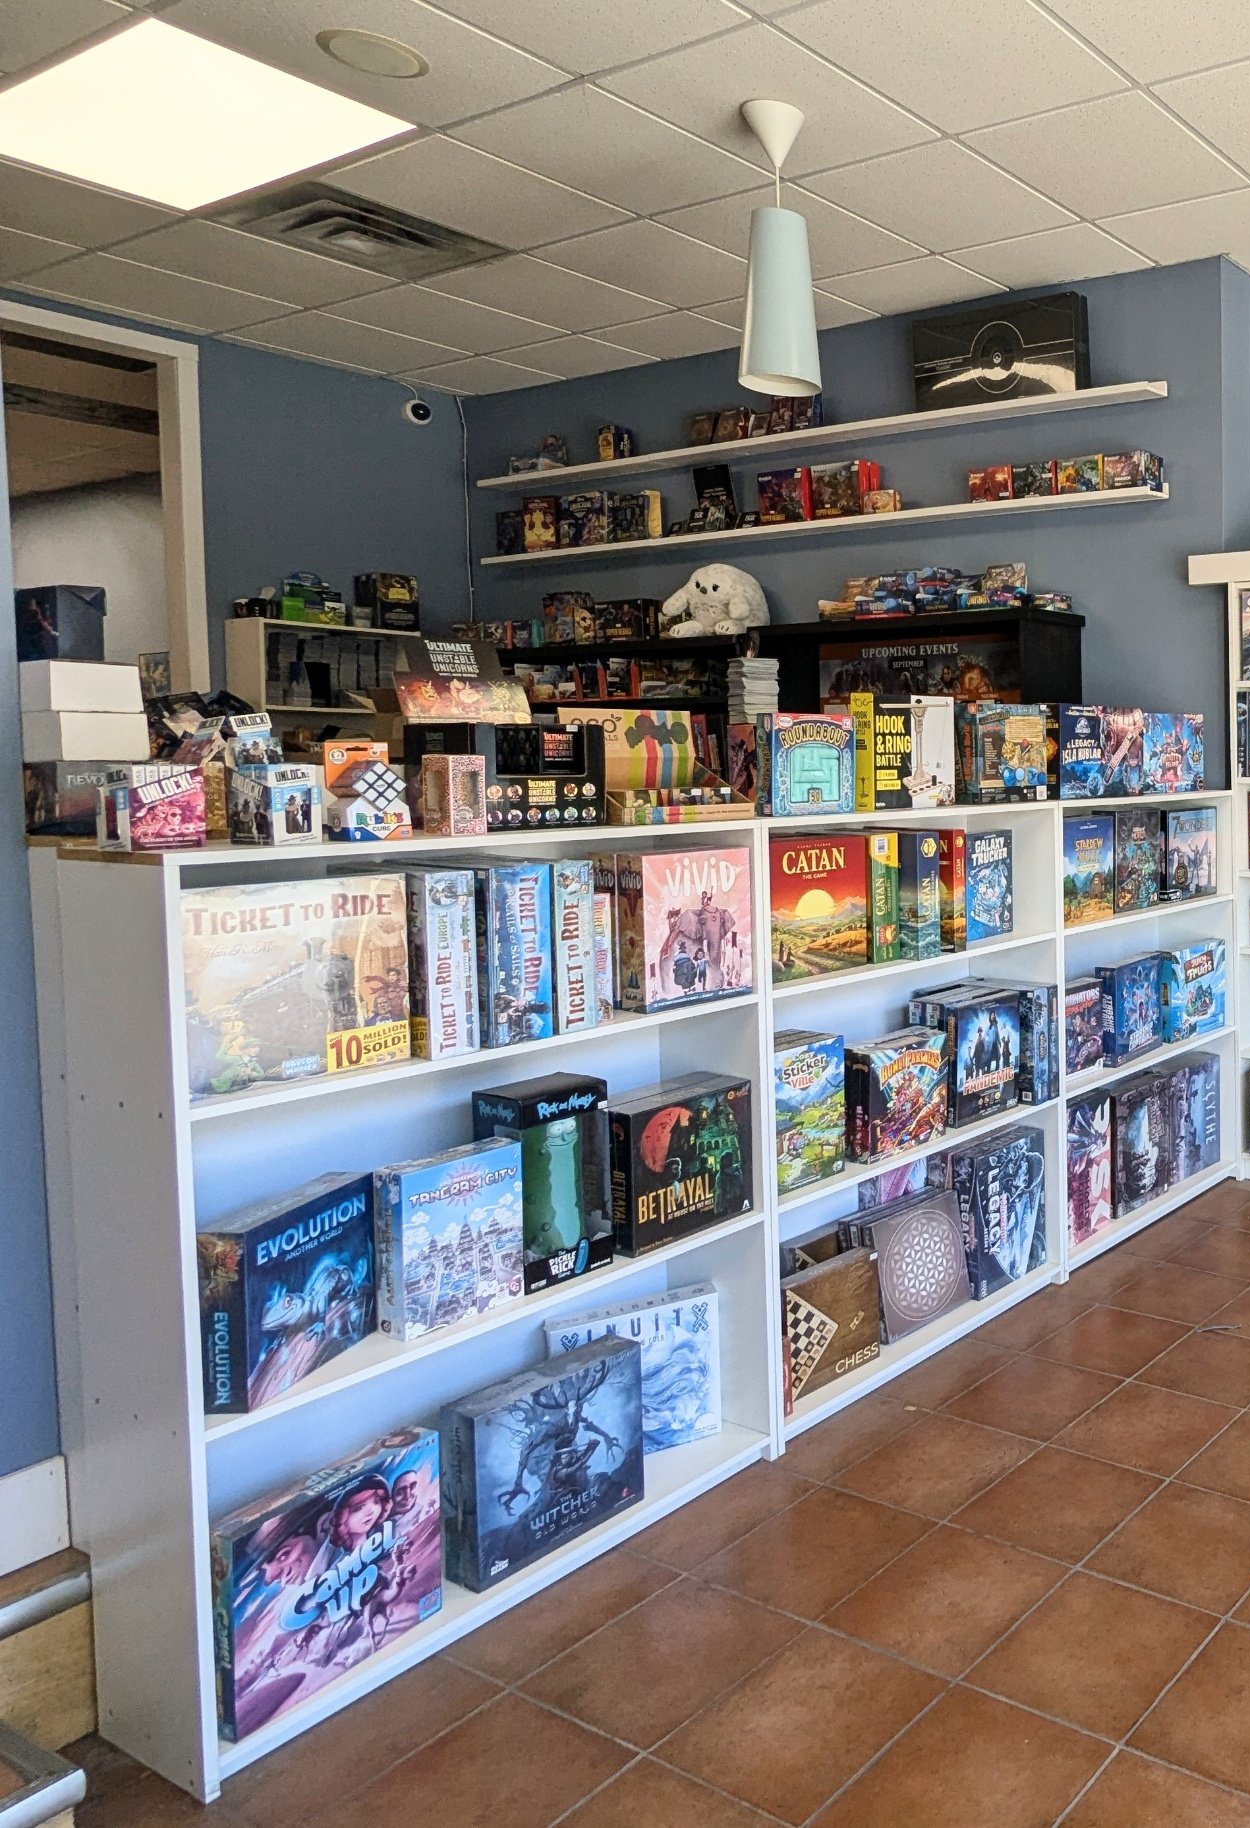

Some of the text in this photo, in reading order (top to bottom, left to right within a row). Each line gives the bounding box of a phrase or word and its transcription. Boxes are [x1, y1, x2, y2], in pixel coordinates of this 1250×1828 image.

[426, 640, 474, 653] ULTIMATE
[430, 653, 477, 665] UNSTABLE
[862, 643, 958, 658] UPCOMING EVENTS
[433, 663, 479, 673] UNICORNS
[892, 660, 924, 669] SEPTEMBER
[234, 714, 268, 728] UNLOCK!
[779, 723, 850, 748] ROUNDABOUT
[876, 715, 905, 734] HOOK
[543, 732, 574, 741] ULTIMATE
[876, 754, 901, 766] BATTLE
[138, 770, 194, 802] UNLOCK!
[972, 848, 1008, 866] TRUCKER
[974, 836, 1004, 851] GALAXY
[782, 847, 846, 875] CATAN
[519, 874, 539, 941] TICKET
[875, 878, 885, 916] CATAN
[186, 892, 394, 936] TICKET TO RIDE
[524, 956, 543, 996] RIDE
[561, 898, 585, 1029] TICKET TO RIDE
[436, 912, 456, 1053] TICKET TO RIDE EUROPE
[363, 1035, 408, 1055] SOLD!
[364, 1023, 407, 1040] MILLION
[330, 1035, 363, 1070] 10
[783, 1054, 826, 1080] Sticker
[788, 1076, 815, 1090] Ville
[962, 1066, 1014, 1095] PANDEMIC
[1204, 1080, 1217, 1145] SCYTHE
[409, 1166, 518, 1207] TANGRAM CITY
[613, 1170, 626, 1224] BETRAYAL
[638, 1173, 714, 1224] BETRAYAL
[960, 1194, 970, 1252] LEGACY
[987, 1168, 1000, 1255] LEGACY
[256, 1193, 366, 1266] EVOLUTION
[285, 1226, 343, 1262] ANOTHER WORLD
[549, 1251, 576, 1268] PICKLE
[551, 1260, 575, 1276] RICK
[587, 1307, 683, 1342] INUIT
[214, 1312, 231, 1406] EVOLUTION
[835, 1342, 879, 1374] CHESS
[530, 1485, 602, 1530] WITCHER
